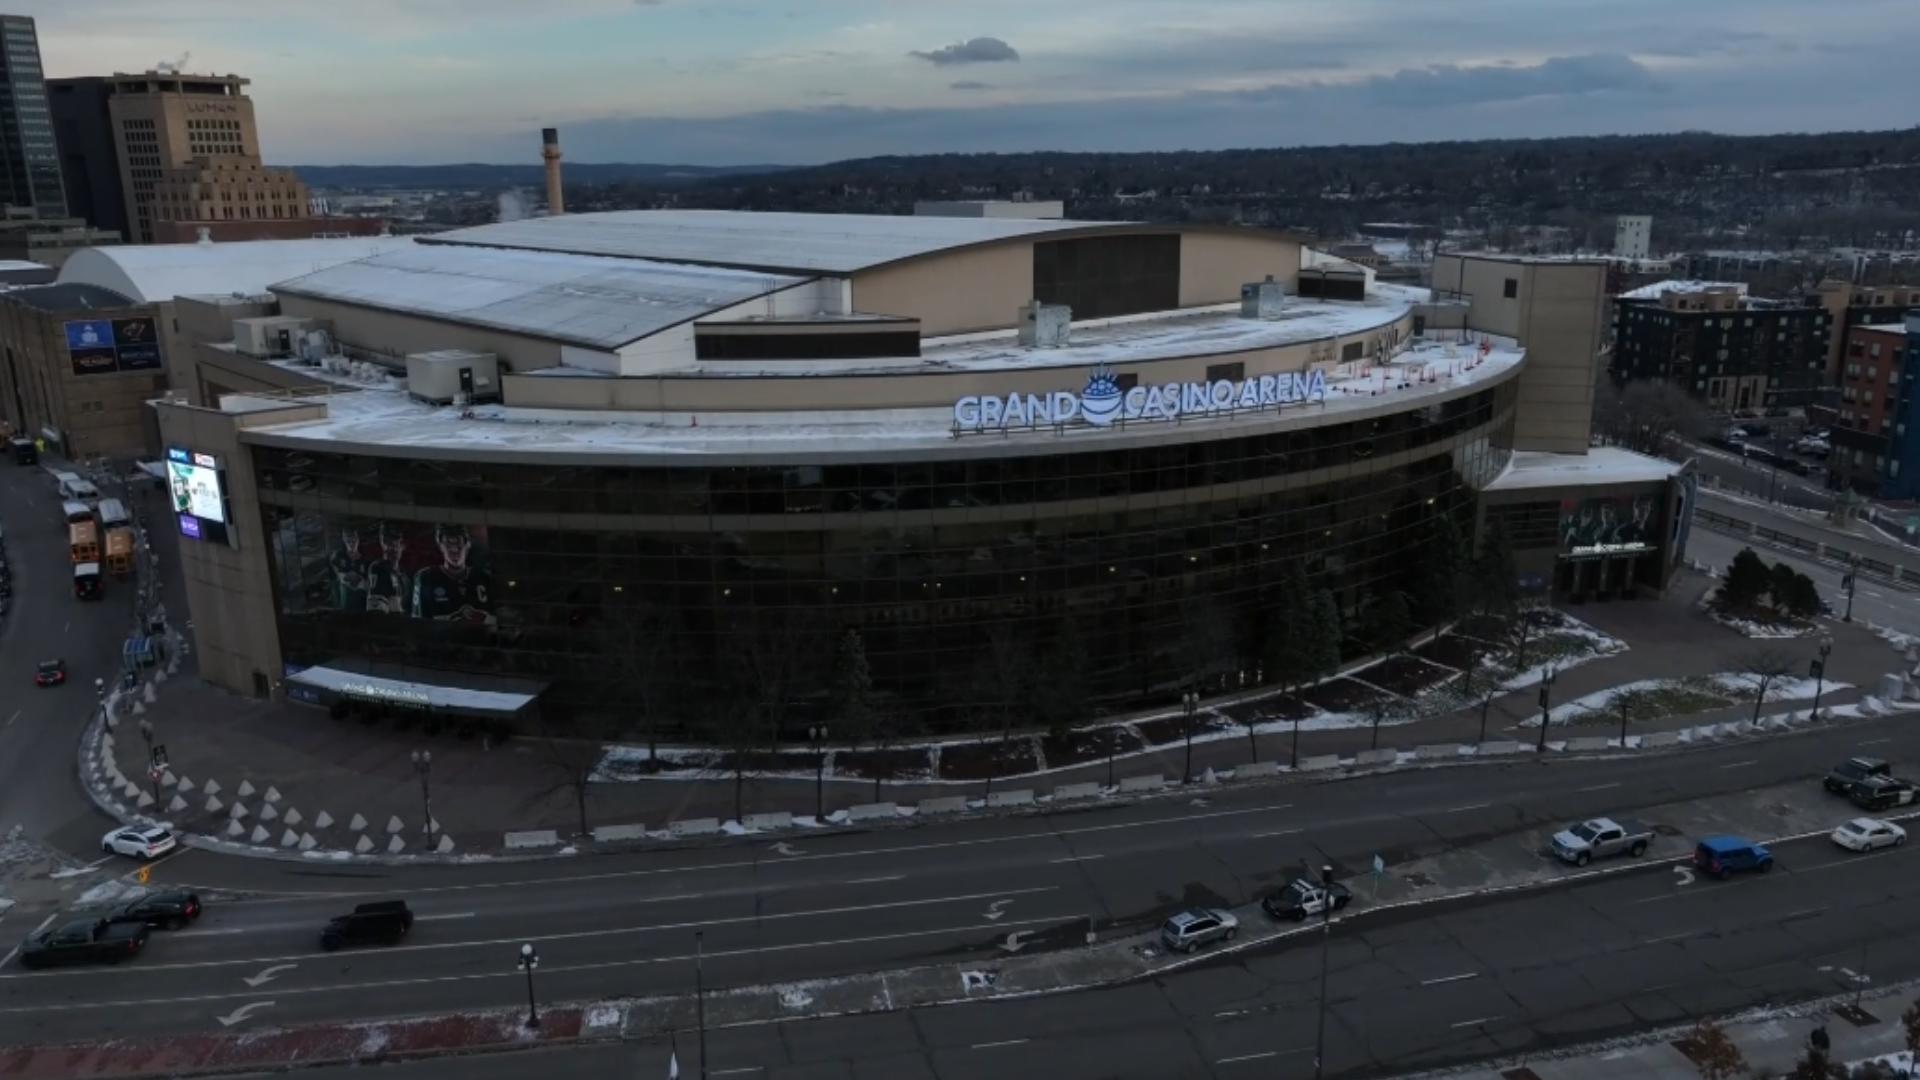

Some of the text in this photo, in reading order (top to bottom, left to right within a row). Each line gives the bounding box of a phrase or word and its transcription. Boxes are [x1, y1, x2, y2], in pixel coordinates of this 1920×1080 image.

[954, 369, 1328, 426] GRAND CASINO ARENA
